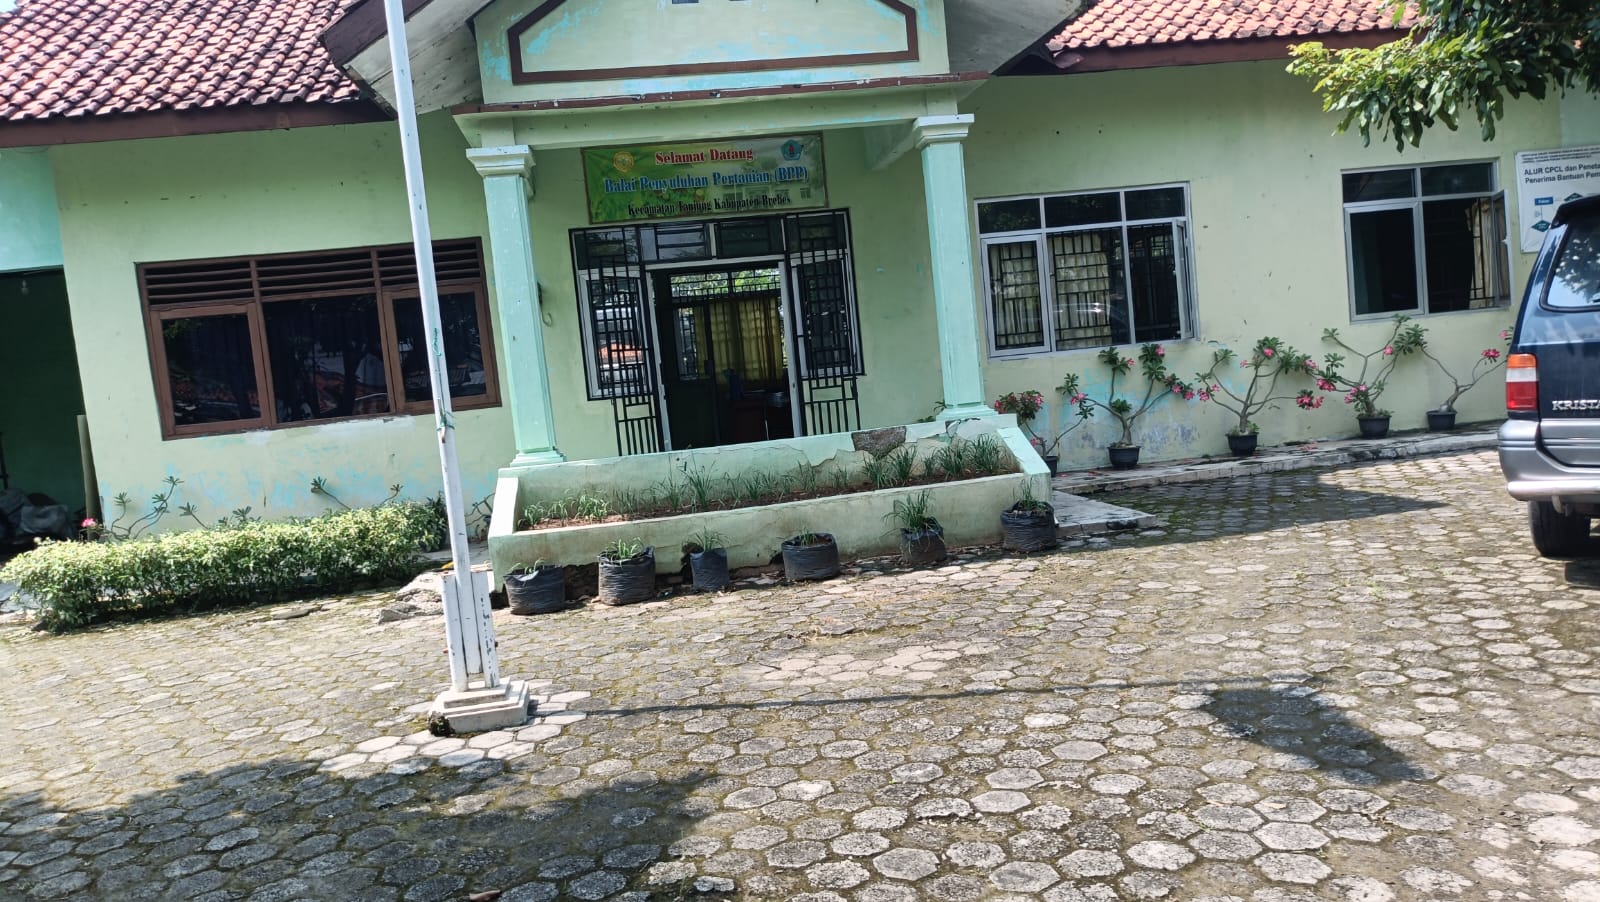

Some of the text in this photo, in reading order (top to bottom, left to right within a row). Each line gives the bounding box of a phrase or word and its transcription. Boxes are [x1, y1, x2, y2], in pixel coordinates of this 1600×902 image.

[655, 147, 753, 165] Selamat Datang
[1524, 168, 1543, 176] ALUR
[1544, 166, 1563, 174] CPCL
[604, 166, 808, 193] Balai Penyuluhan Pertanian (BPP)
[1525, 175, 1555, 184] Penerima
[1557, 173, 1583, 181] Bantuan
[628, 202, 675, 216] Kecamatan
